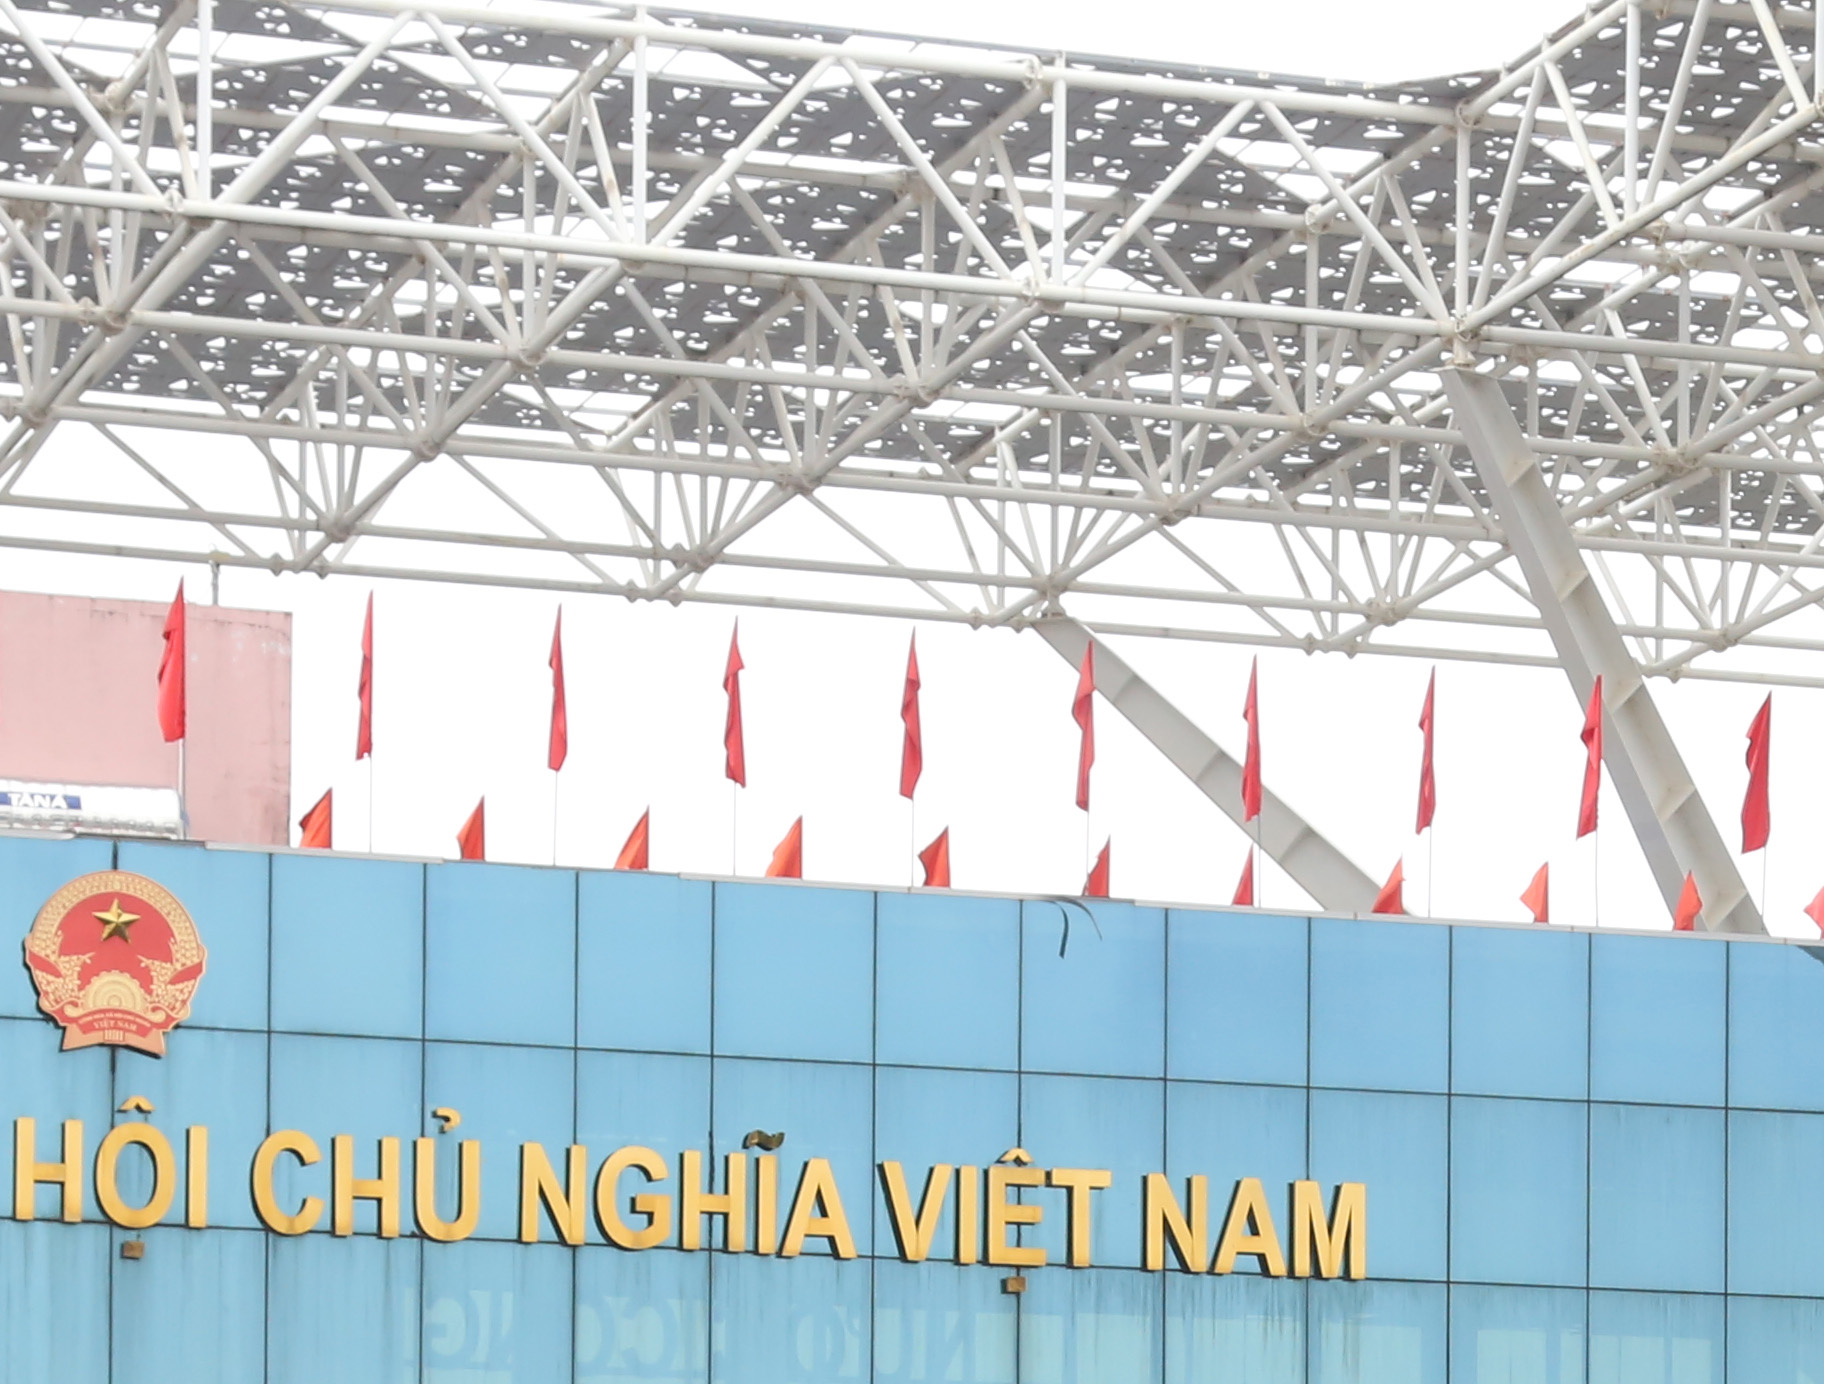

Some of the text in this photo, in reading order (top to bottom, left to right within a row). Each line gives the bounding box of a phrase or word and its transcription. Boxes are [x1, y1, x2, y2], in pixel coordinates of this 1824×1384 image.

[13, 1096, 206, 1260] HỘI
[252, 1107, 479, 1243] CHỦ
[521, 1130, 857, 1261] NGHĨA
[880, 1147, 1110, 1293] VIỆT
[1146, 1173, 1365, 1280] NAM
